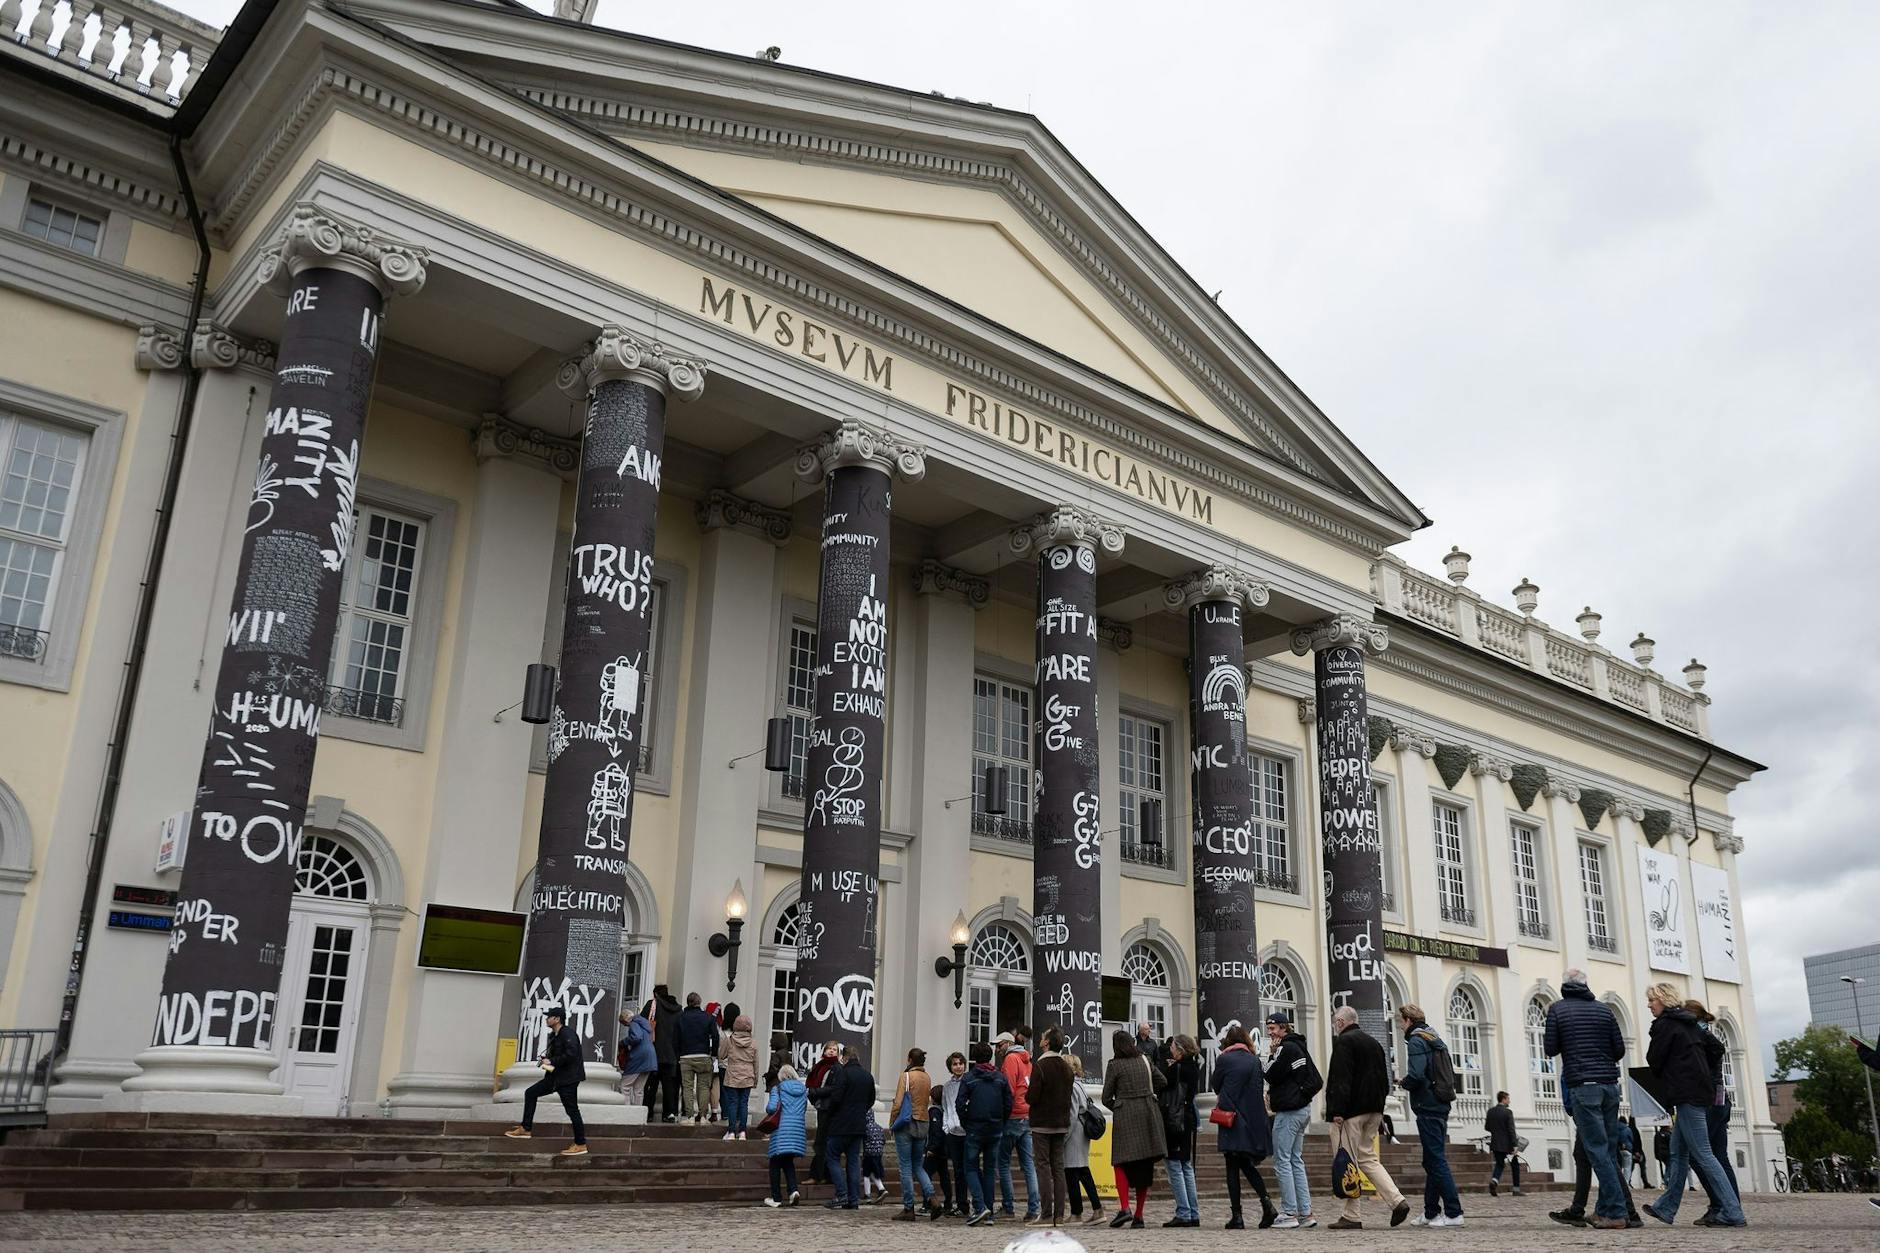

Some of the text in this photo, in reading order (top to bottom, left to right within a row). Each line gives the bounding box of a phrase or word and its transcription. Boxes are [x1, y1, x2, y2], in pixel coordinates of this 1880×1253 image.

[700, 277, 1212, 525] MVSEVM FRIDERICIANVM
[582, 572, 650, 619] WHO?
[849, 618, 887, 649] NOT
[1045, 611, 1085, 635] FIT
[832, 798, 866, 816] STOP
